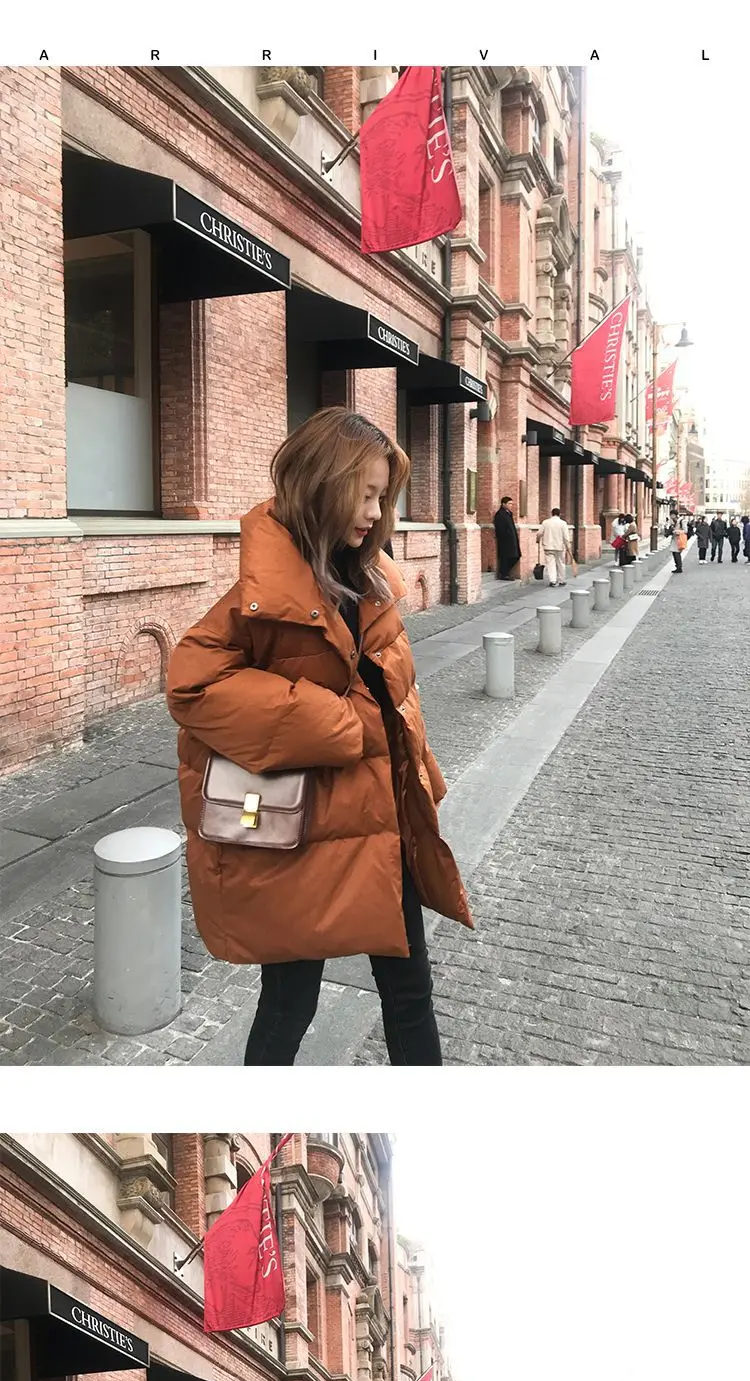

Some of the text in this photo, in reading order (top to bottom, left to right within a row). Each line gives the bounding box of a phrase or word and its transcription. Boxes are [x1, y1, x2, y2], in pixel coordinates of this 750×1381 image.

[200, 212, 272, 270] CHRISTIE'S
[600, 312, 623, 401] CHRISTIE'S
[71, 1306, 134, 1353] CHRISTIE'S
